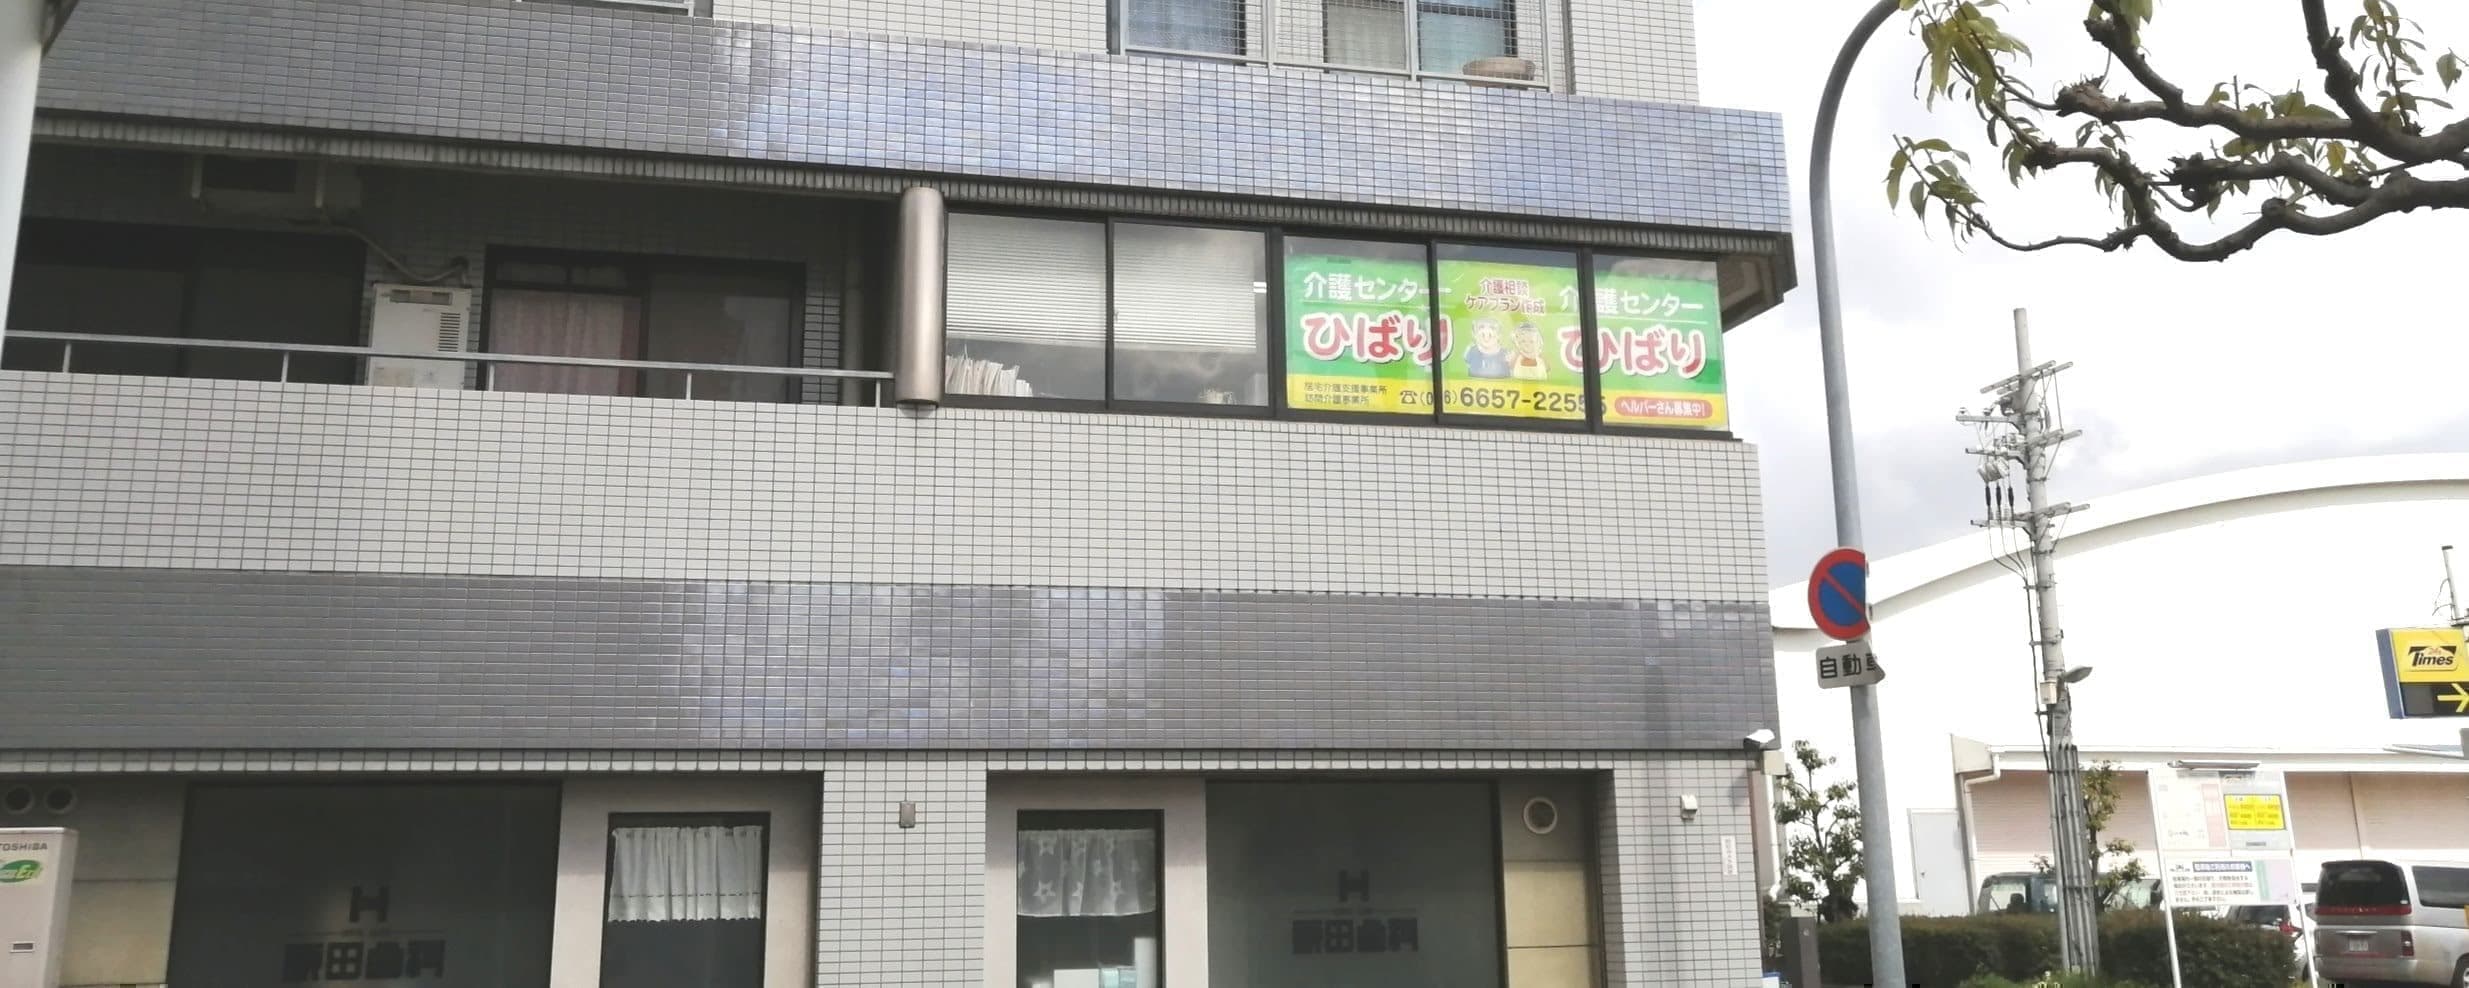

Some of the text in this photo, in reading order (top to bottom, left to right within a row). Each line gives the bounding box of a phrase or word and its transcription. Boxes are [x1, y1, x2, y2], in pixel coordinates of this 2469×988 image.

[1303, 271, 1452, 302] 介護センター
[1560, 285, 1704, 317] 介護センター
[1302, 312, 1452, 365] ひばり
[1558, 325, 1705, 377] ひばり
[2408, 645, 2457, 667] Times
